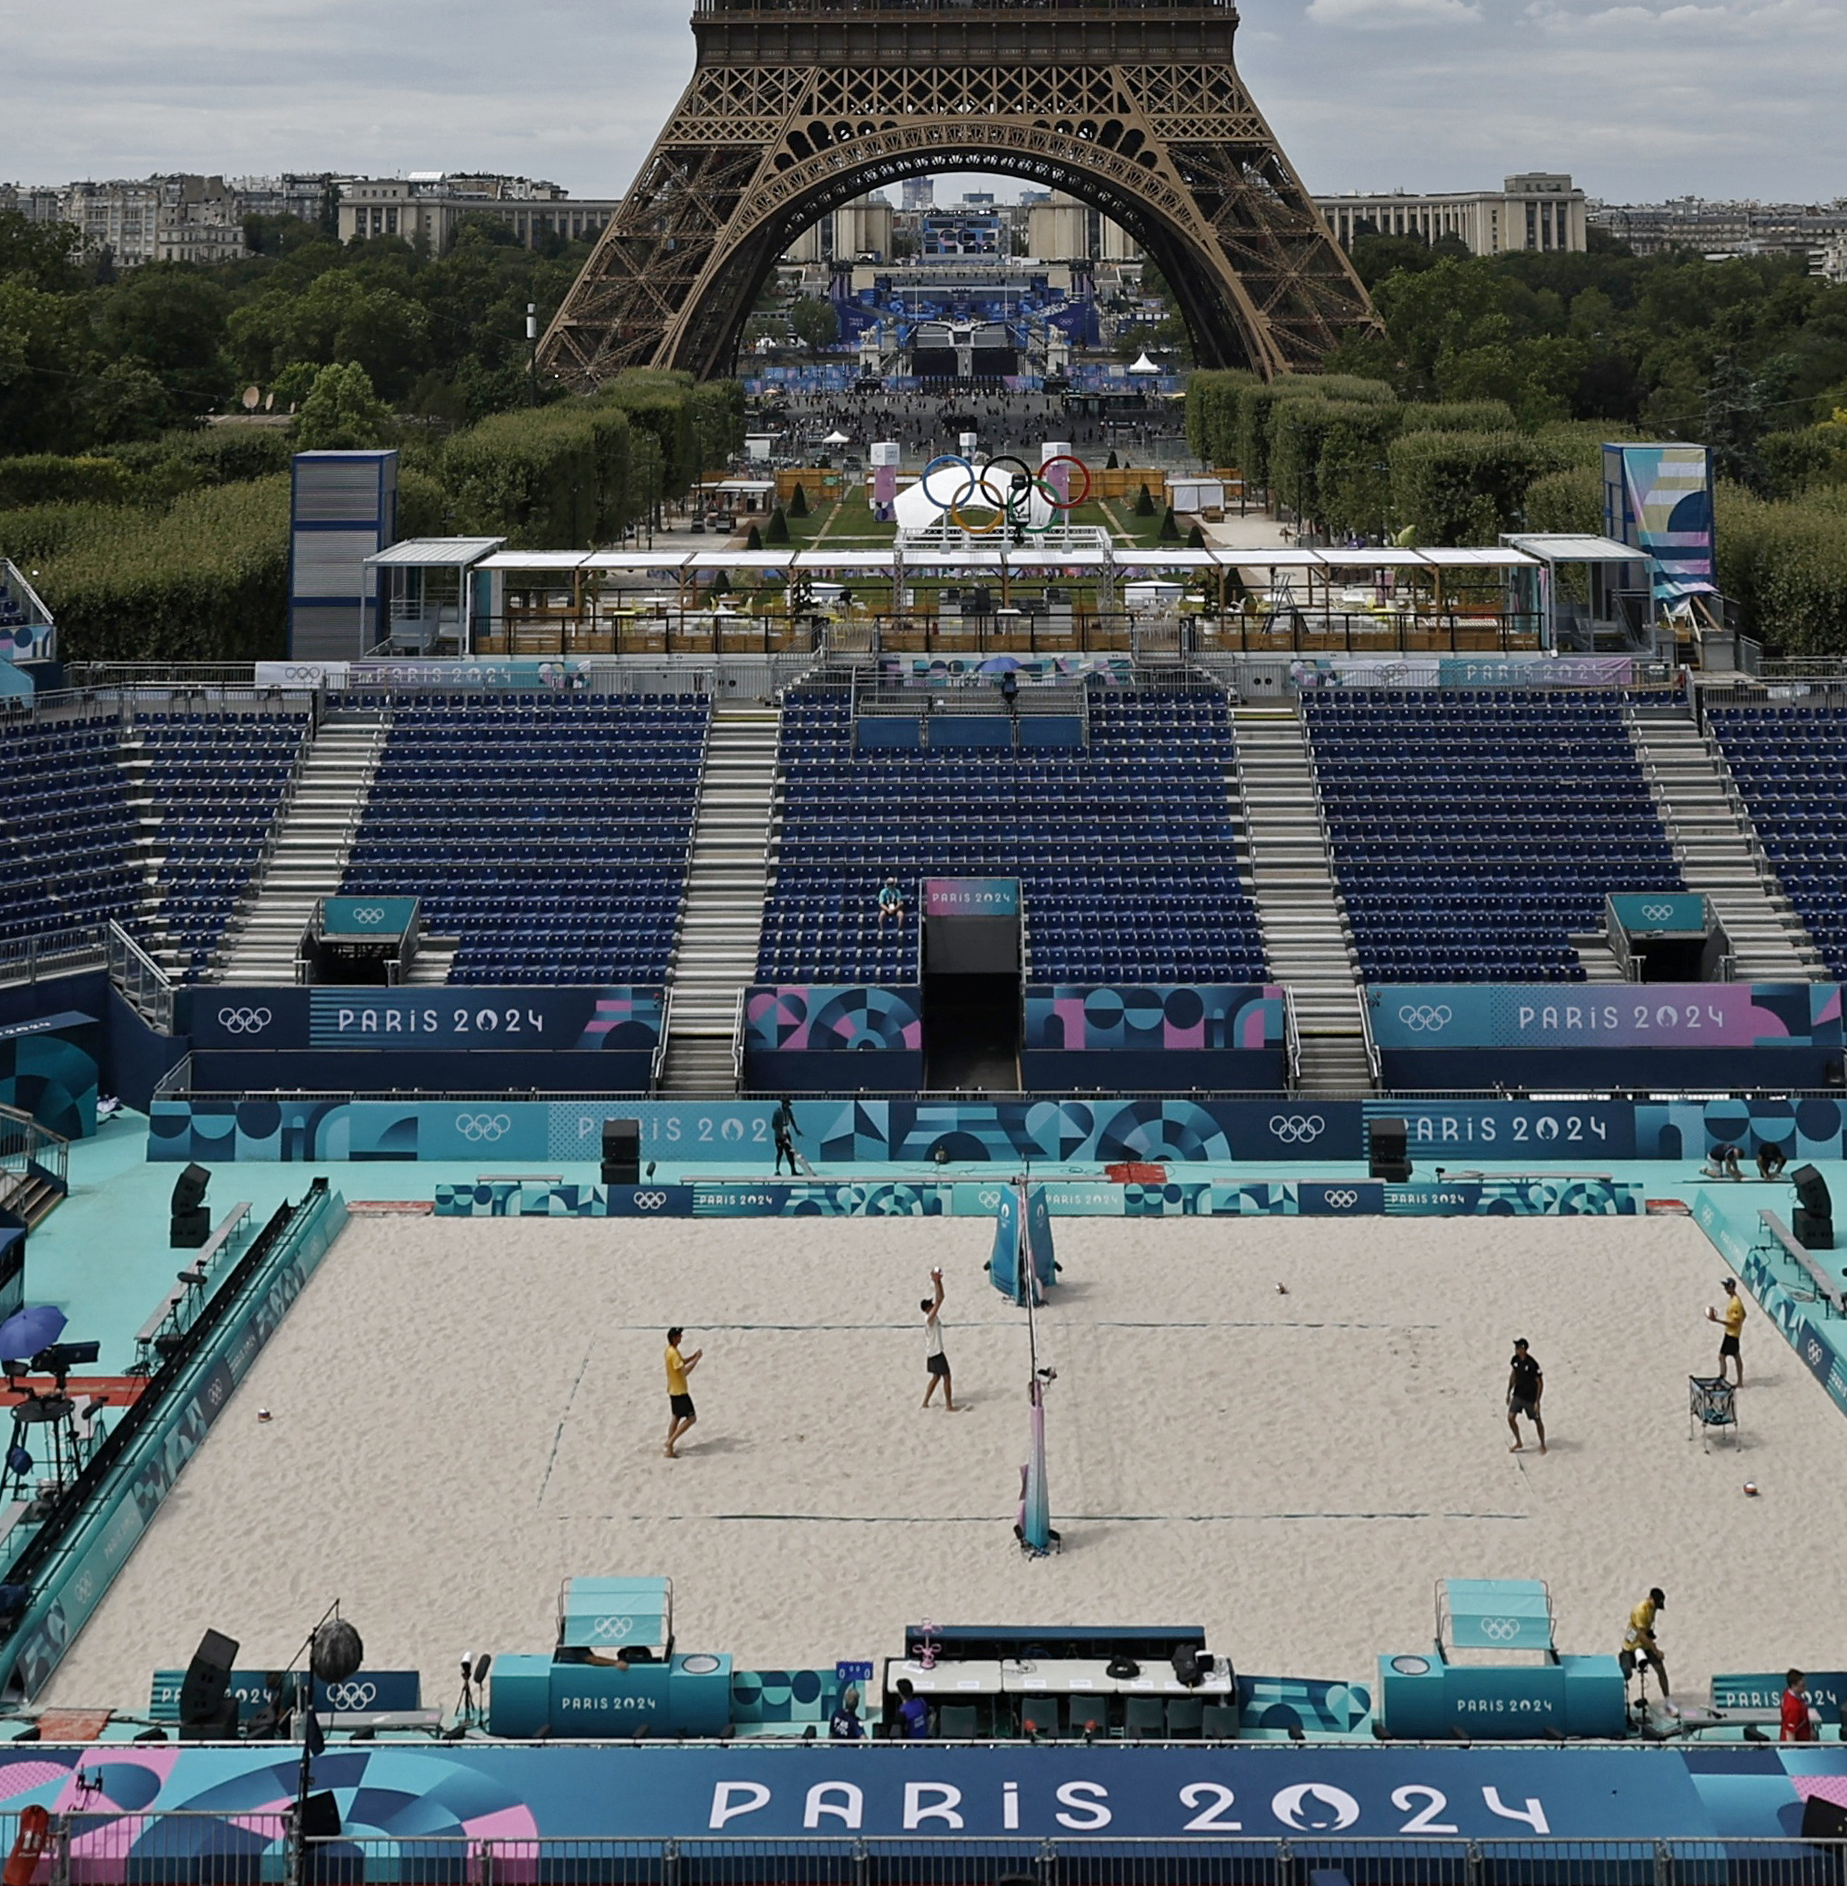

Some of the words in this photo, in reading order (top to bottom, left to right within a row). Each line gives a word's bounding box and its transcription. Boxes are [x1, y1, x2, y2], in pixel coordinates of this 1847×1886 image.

[453, 667, 512, 683] 2024
[1543, 663, 1604, 681] 2024
[975, 893, 1010, 903] 2024
[454, 1008, 543, 1033] 2024
[1633, 1005, 1724, 1028] 2024
[698, 1118, 767, 1142] 202
[1512, 1116, 1606, 1141] 2024
[740, 1194, 773, 1205] 2024
[1085, 1194, 1118, 1204] 2024
[1432, 1194, 1465, 1204] 2024
[613, 1697, 656, 1710] 2024
[1801, 1690, 1837, 1705] 024
[1509, 1699, 1552, 1712] 2024
[1179, 1781, 1551, 1835] 2024
